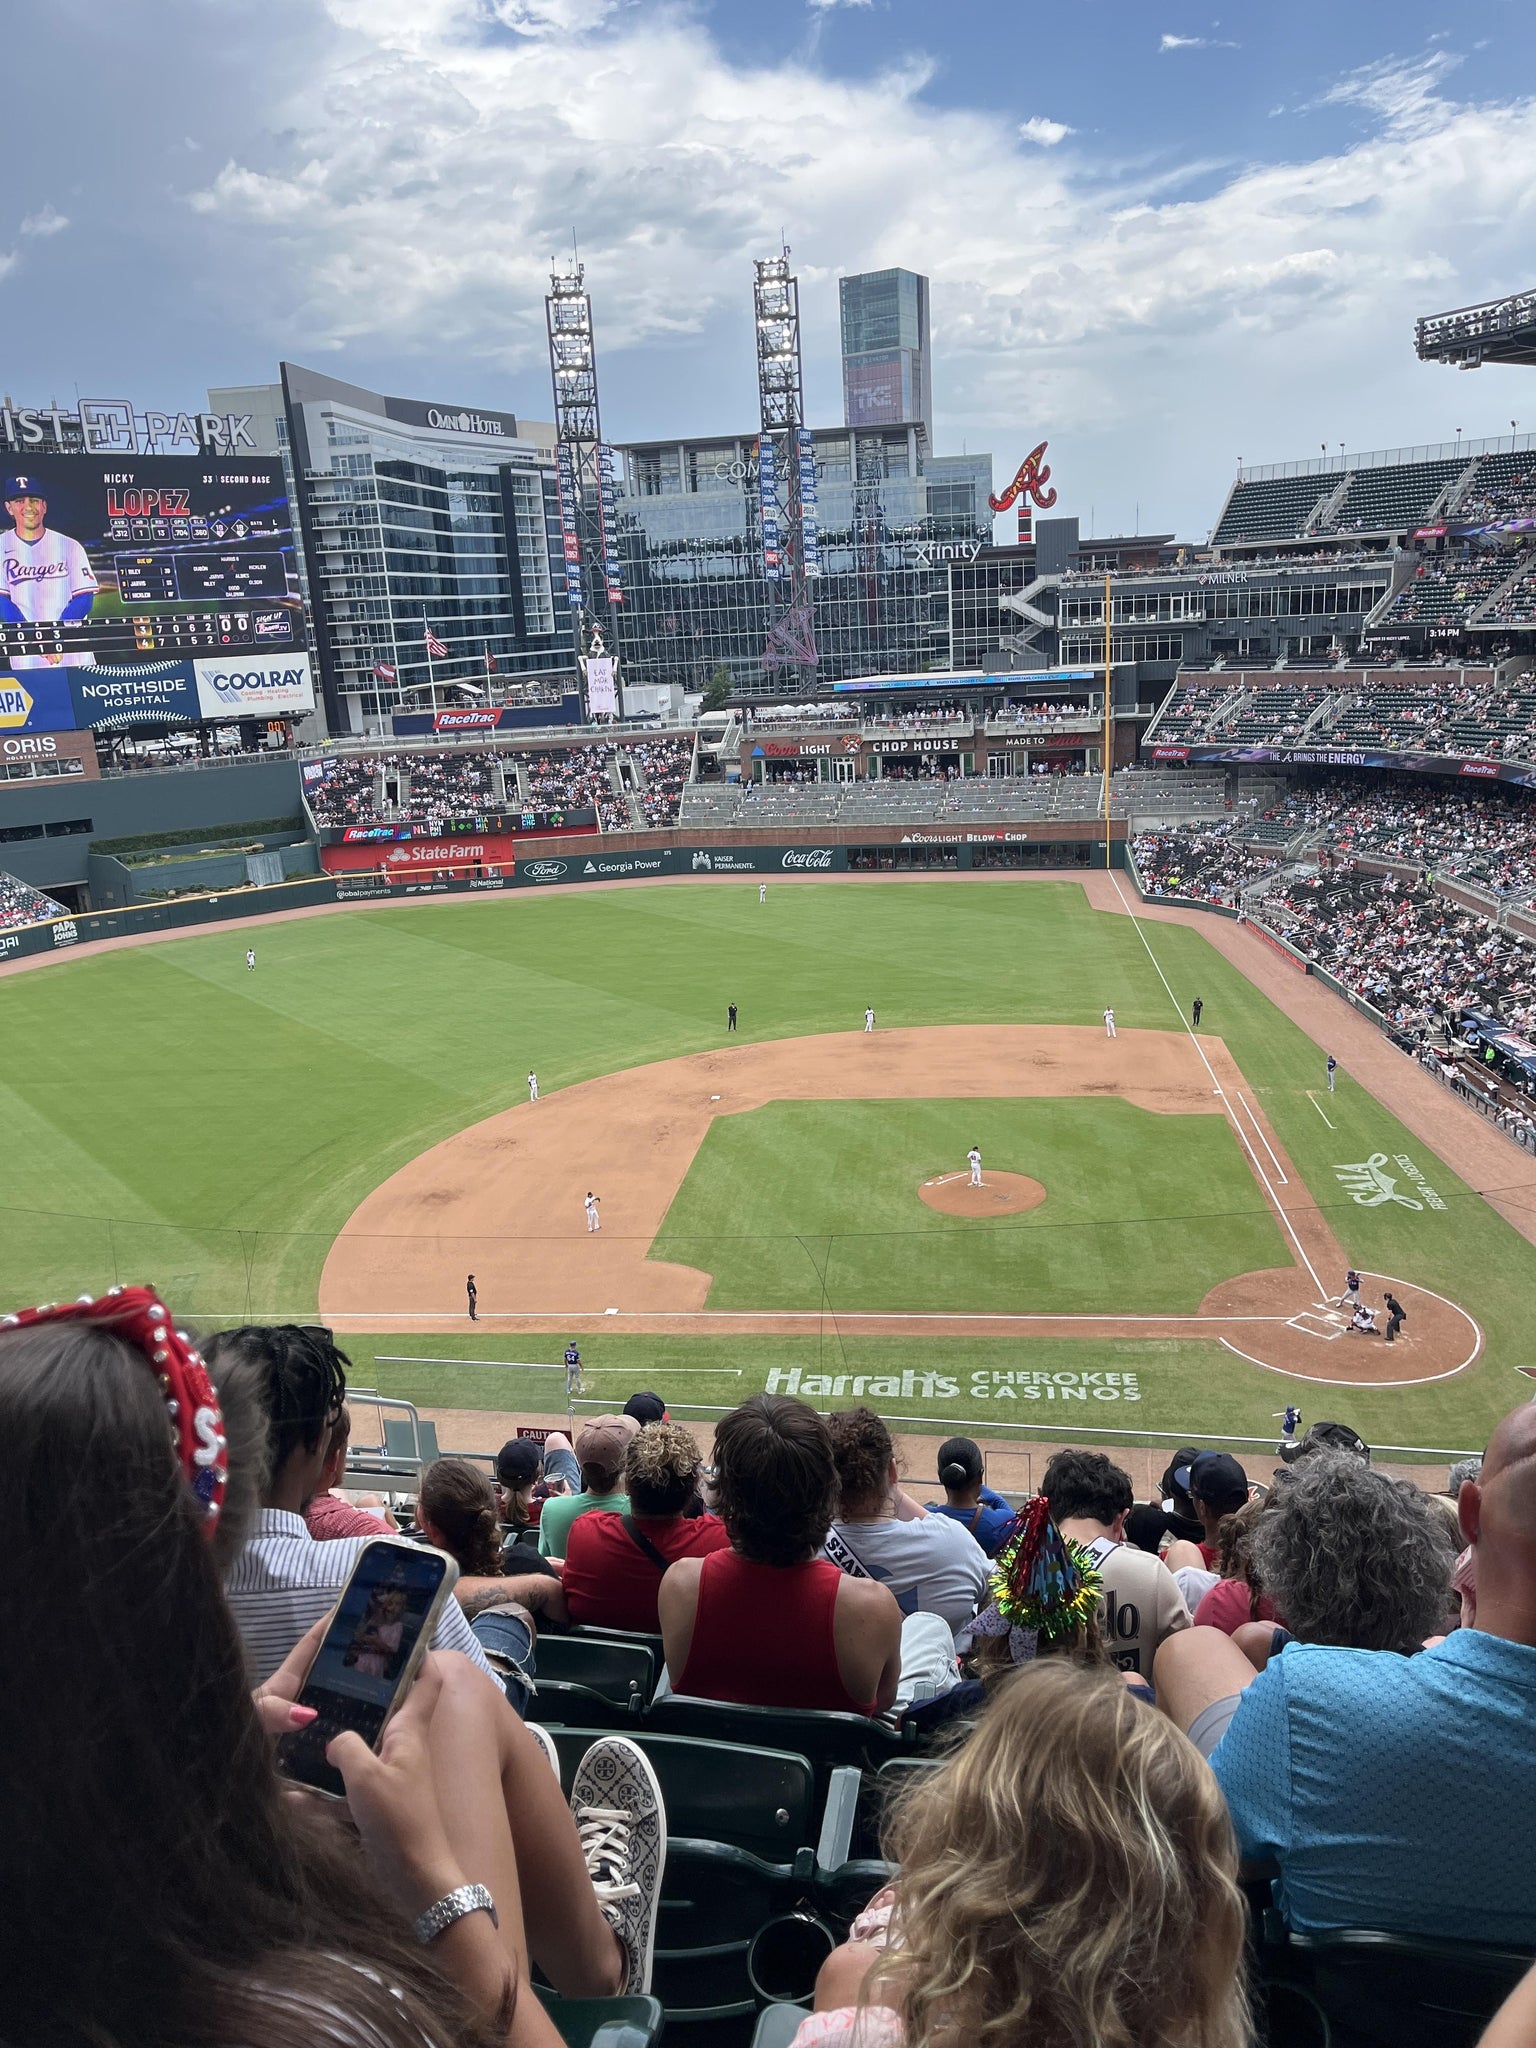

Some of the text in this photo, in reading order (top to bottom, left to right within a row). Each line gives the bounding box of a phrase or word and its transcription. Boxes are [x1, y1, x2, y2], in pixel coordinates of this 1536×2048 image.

[2, 407, 256, 447] IST PARK
[428, 408, 504, 435] OMNI HOTEL
[16, 476, 28, 488] T
[104, 474, 134, 483] NICKY
[203, 475, 213, 483] 33
[220, 475, 249, 484] SECOND
[107, 488, 190, 516] LOPEZ
[115, 529, 128, 537] .312
[916, 541, 982, 565] xfinity
[608, 578, 620, 586] 1992
[1208, 572, 1248, 584] MILNER
[221, 618, 248, 632] 0 0
[18, 632, 24, 640] 0
[36, 631, 42, 640] 0
[54, 630, 60, 638] 3
[140, 626, 146, 634] 3
[156, 626, 162, 634] 7
[173, 624, 180, 632] 0
[189, 624, 196, 632] 6
[205, 623, 212, 631] 2
[1429, 628, 1460, 637] 3:14 PM
[2, 636, 214, 655] 1 1 1 0 4 7 1 5 2
[213, 668, 304, 691] COOLRAY
[82, 679, 186, 698] NORTHSIDE
[104, 695, 170, 707] HOSPITAL
[438, 712, 496, 726] RaceTrac
[268, 720, 286, 732] 0:07
[4, 737, 56, 754] ORIS
[872, 740, 958, 752] CHOP HOUSE
[1006, 737, 1032, 746] MADE
[765, 743, 830, 756] Coors LIGHT
[1155, 750, 1186, 758] RaceTrac
[1270, 752, 1280, 760] THE
[1294, 752, 1316, 762] BRINGS
[1316, 753, 1328, 762] THE
[1328, 752, 1366, 764] ENERGY
[1463, 764, 1497, 774] RaceTrac
[348, 828, 394, 838] RaceTrac
[413, 825, 427, 834] NL
[911, 832, 938, 843] Coors
[1004, 832, 1028, 840] CHOP
[782, 850, 834, 868] Coca-Cola
[532, 862, 561, 876] Ford
[598, 860, 662, 873] Georgia Power
[52, 921, 76, 934] PAPA
[54, 930, 78, 942] JOHNS
[970, 1370, 1138, 1387] CHEROKEE
[970, 1385, 1142, 1400] CASINOS
